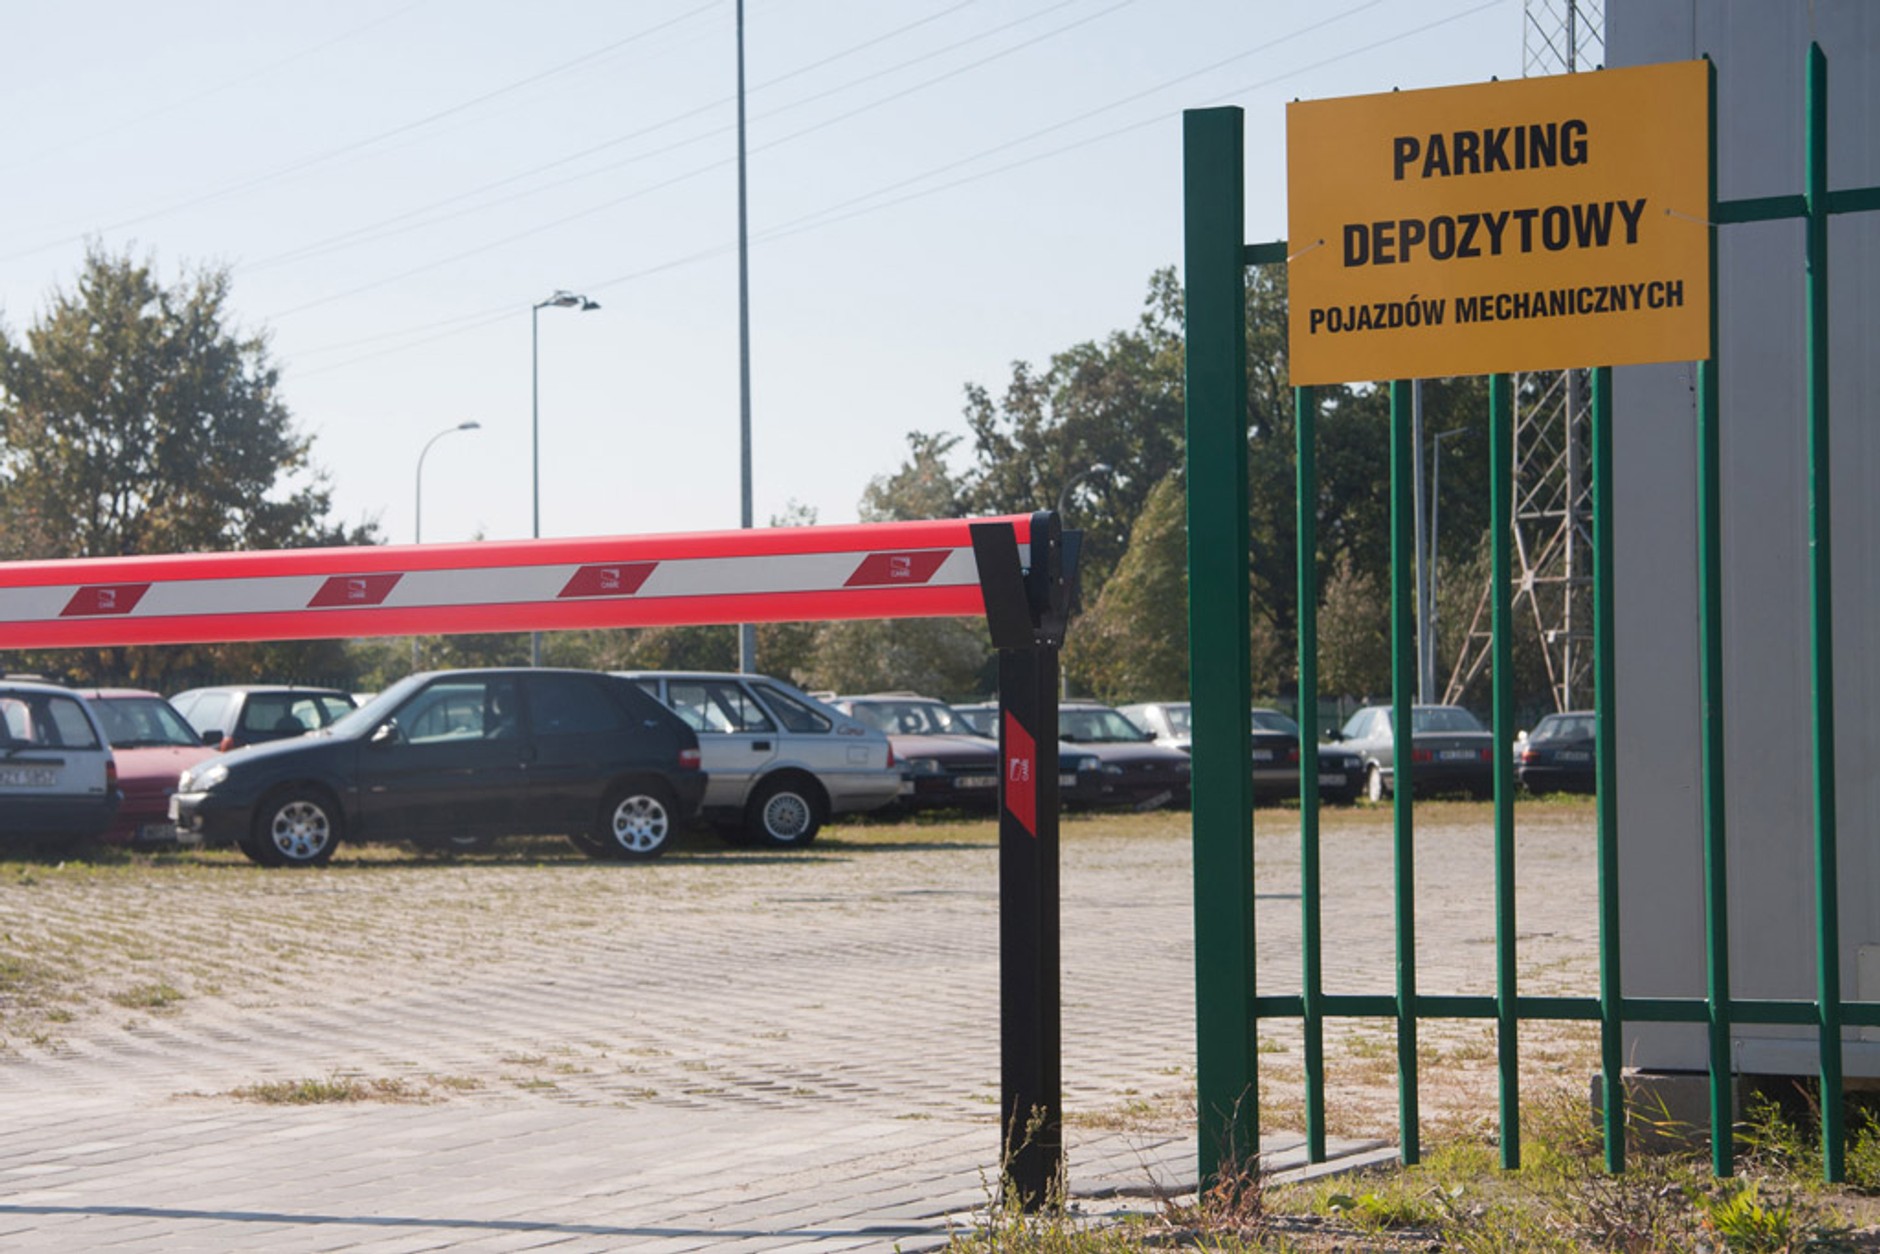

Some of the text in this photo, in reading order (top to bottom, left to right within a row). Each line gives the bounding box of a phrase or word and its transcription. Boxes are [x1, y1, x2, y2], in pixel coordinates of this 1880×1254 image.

[1393, 119, 1588, 181] PARKING
[1343, 198, 1647, 268] DEPOZYTOWY
[1310, 279, 1684, 335] POJAZDÓW MECHANICZNYCH
